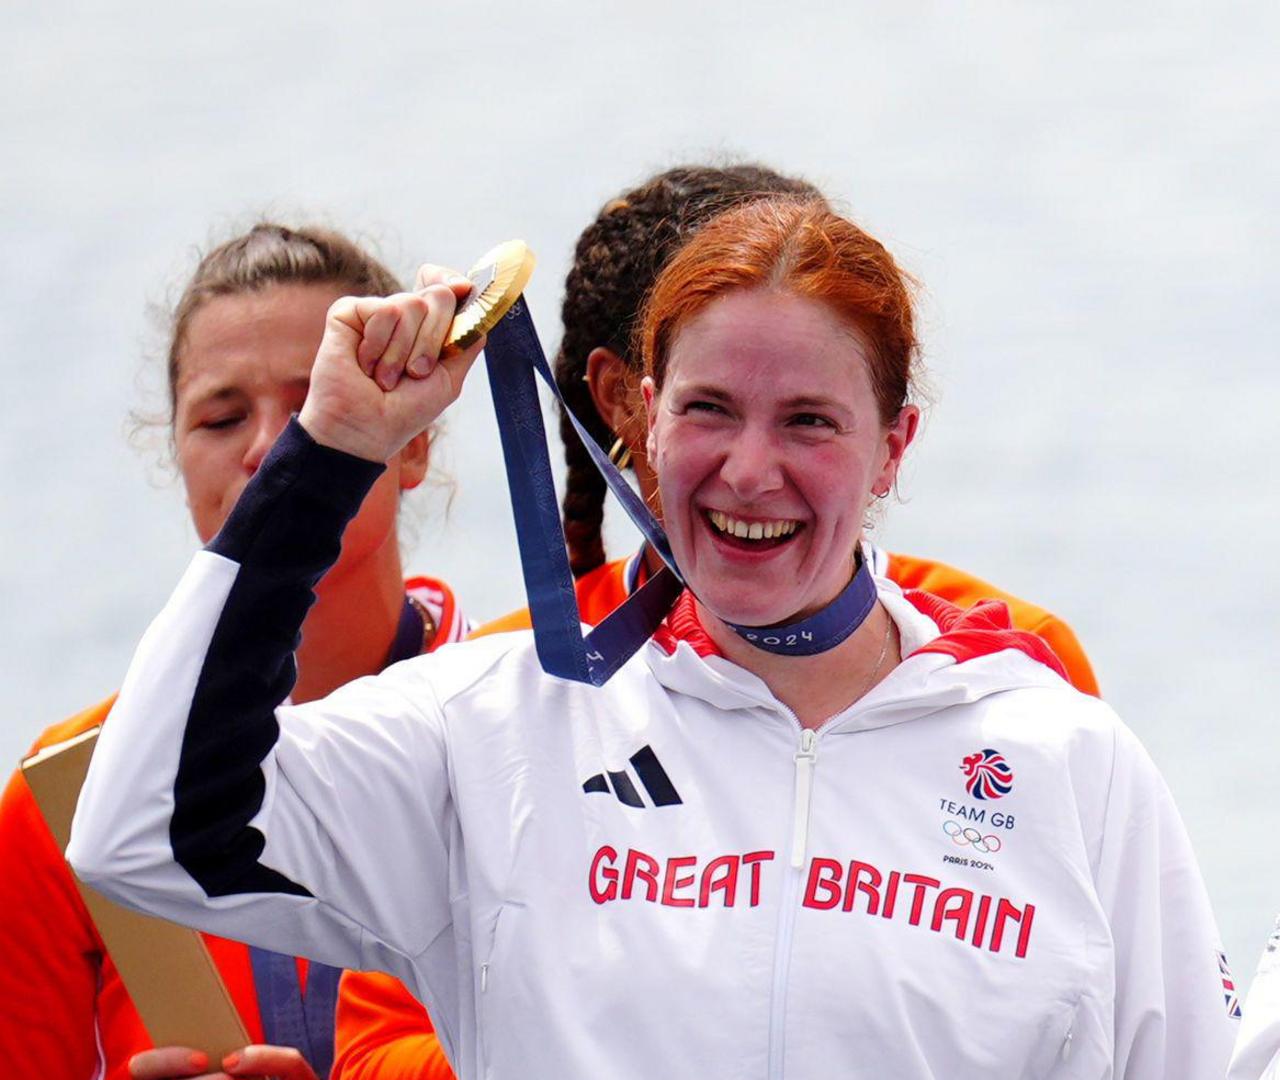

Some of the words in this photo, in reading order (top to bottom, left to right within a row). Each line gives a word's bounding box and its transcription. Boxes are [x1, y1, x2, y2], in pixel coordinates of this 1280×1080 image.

[940, 799, 986, 823] TEAM
[991, 813, 1015, 830] GB
[943, 855, 968, 867] PARIS
[970, 860, 994, 871] 2024
[588, 844, 775, 909] GREAT
[802, 856, 1036, 958] BRITAIN
